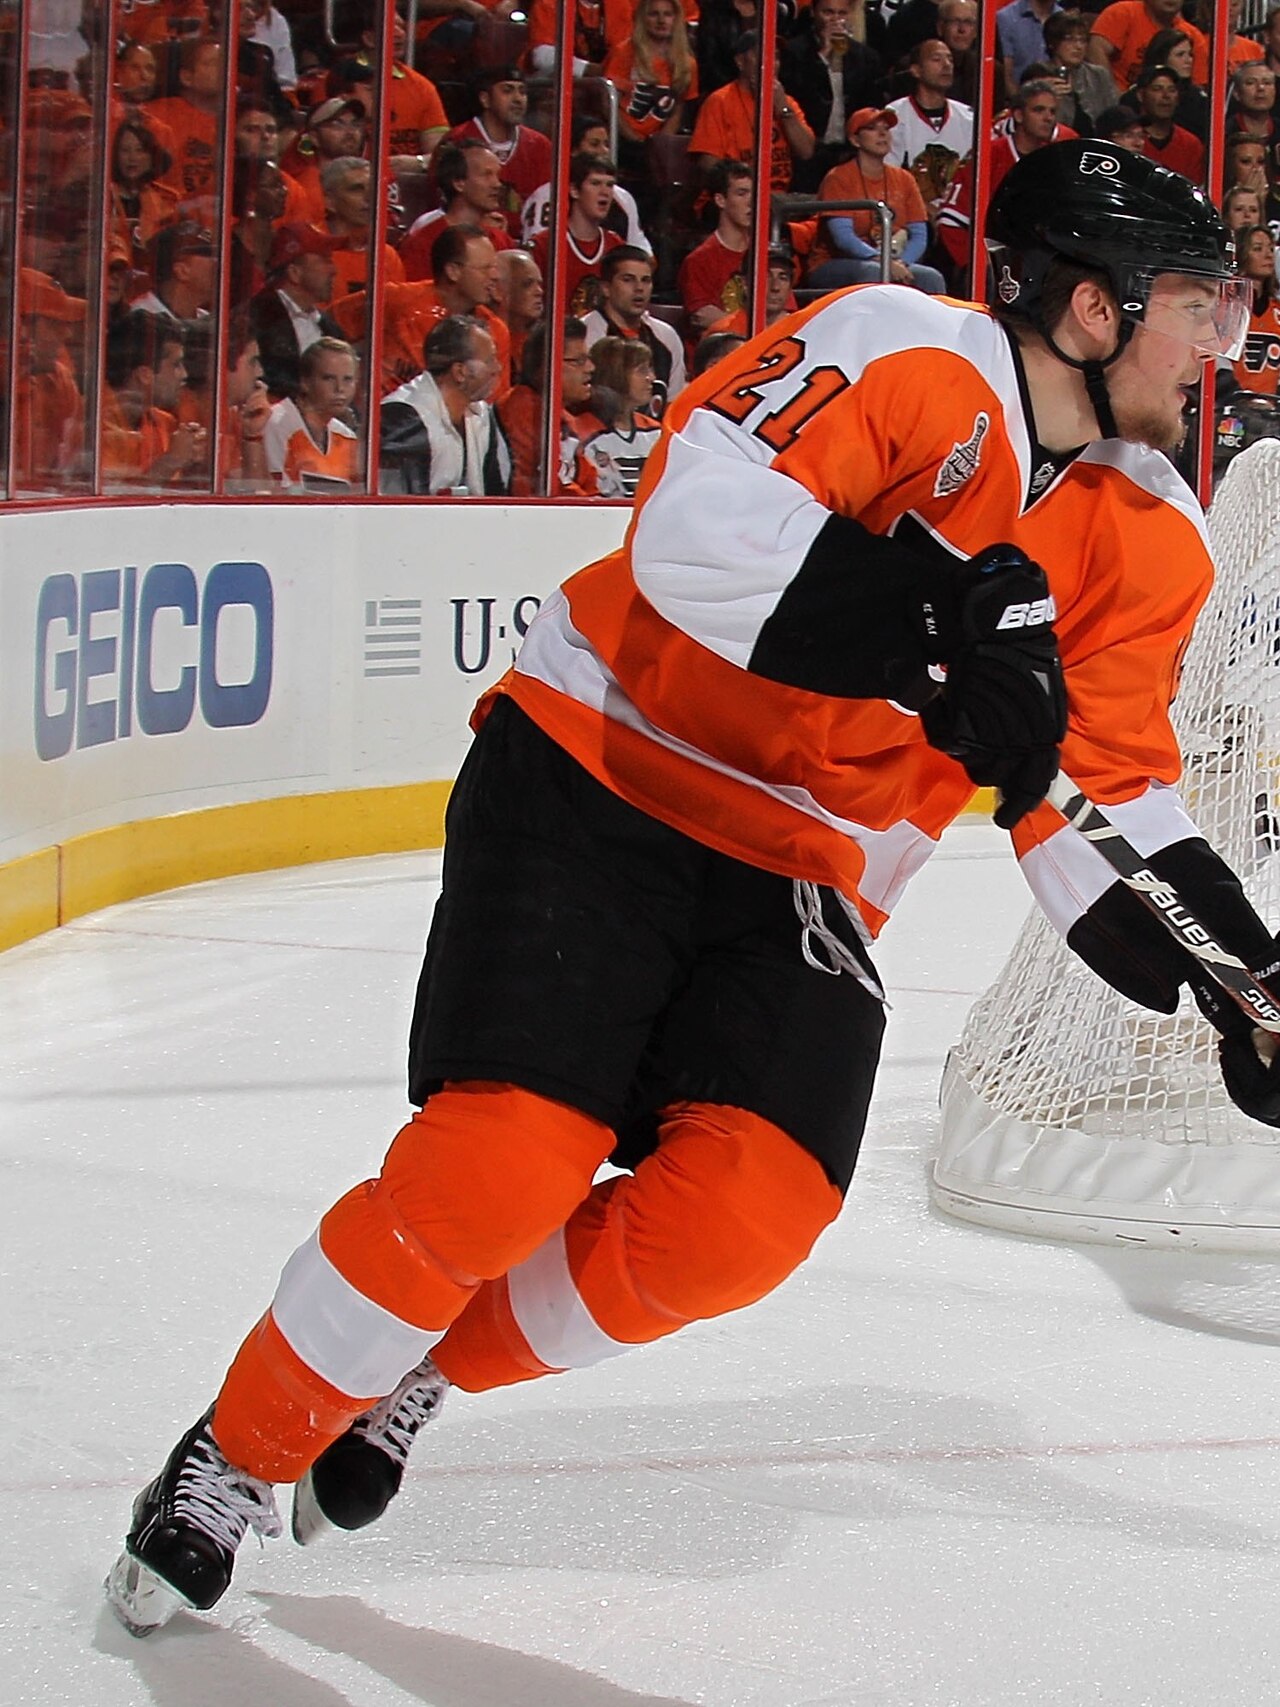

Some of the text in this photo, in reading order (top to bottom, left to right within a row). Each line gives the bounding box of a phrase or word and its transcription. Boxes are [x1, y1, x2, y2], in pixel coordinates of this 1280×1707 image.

[707, 336, 851, 455] 21
[1217, 434, 1243, 449] NBC
[34, 561, 274, 761] GEICO
